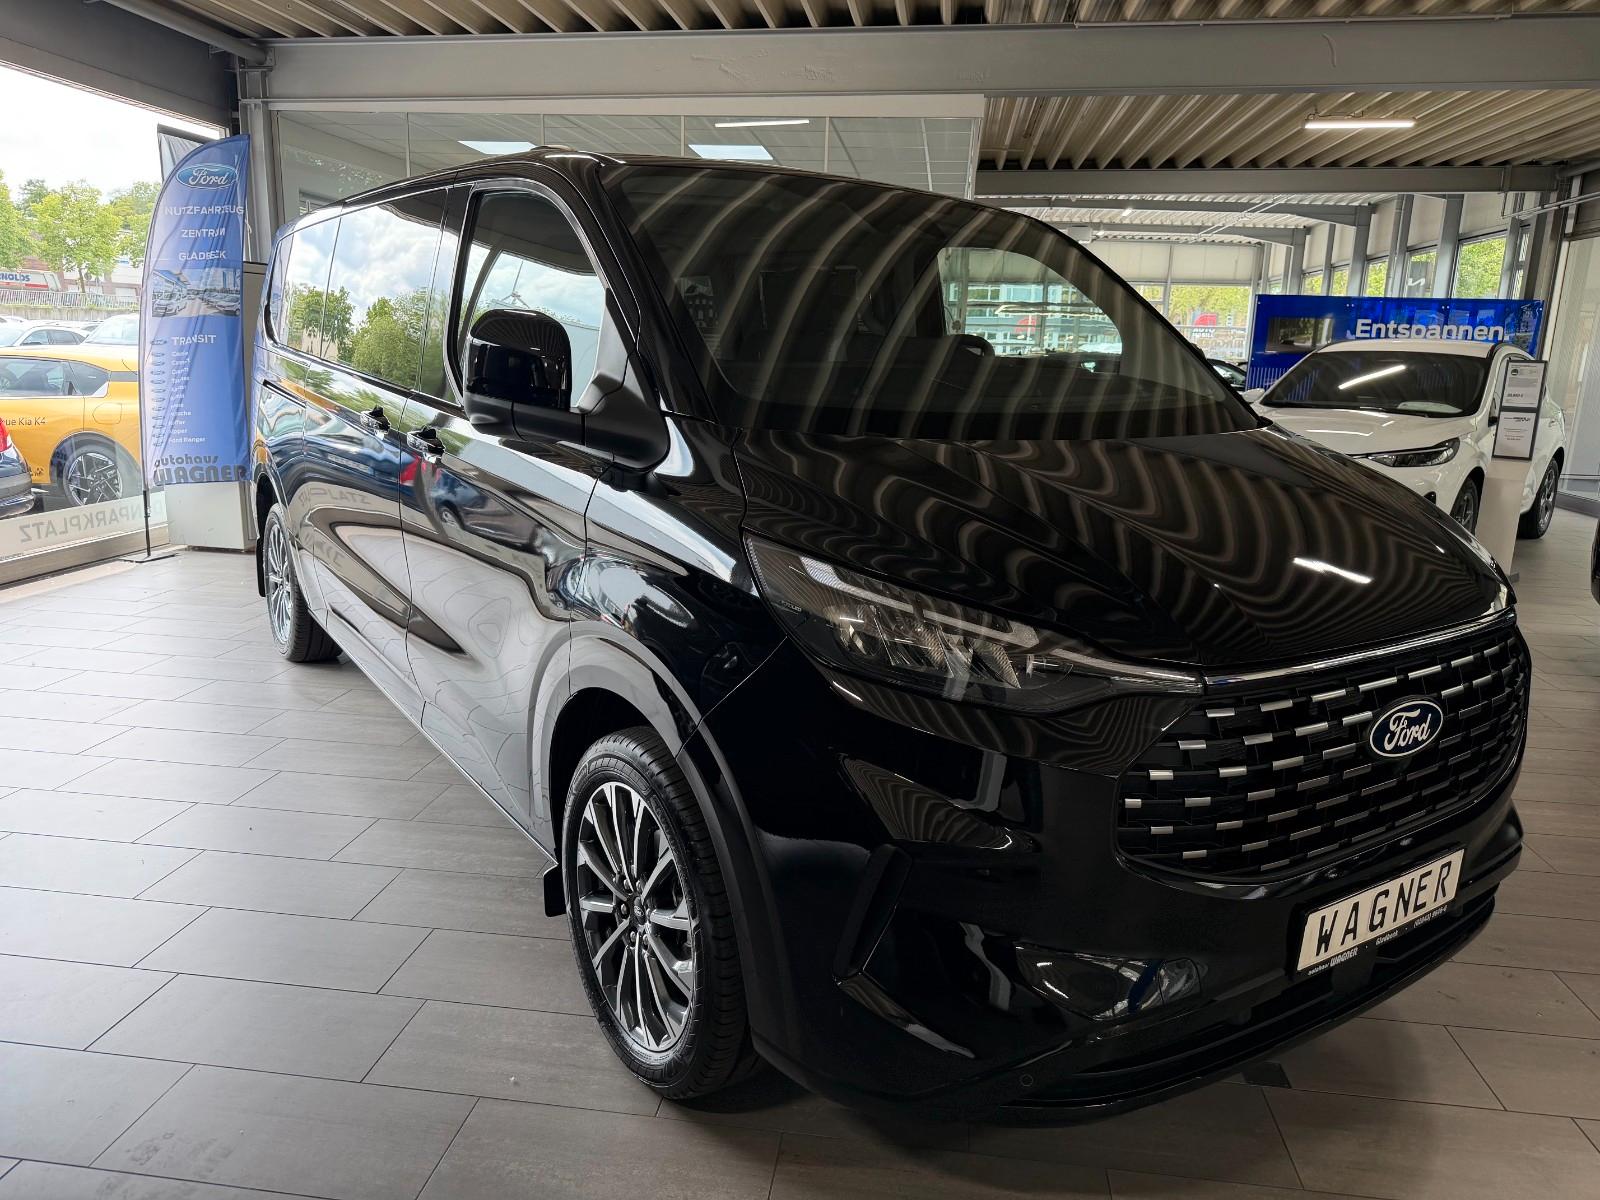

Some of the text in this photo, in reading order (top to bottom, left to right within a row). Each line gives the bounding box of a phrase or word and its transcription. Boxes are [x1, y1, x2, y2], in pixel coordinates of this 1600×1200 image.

[188, 167, 229, 185] Ford
[1355, 318, 1510, 340] Entspannen.
[171, 334, 217, 345] TRANSIT
[18, 417, 32, 426] Kia
[34, 417, 46, 426] K4
[154, 454, 219, 467] autohaus
[153, 464, 248, 486] WAGNER
[1383, 708, 1432, 751] Ford
[1315, 860, 1452, 957] WAGNER
